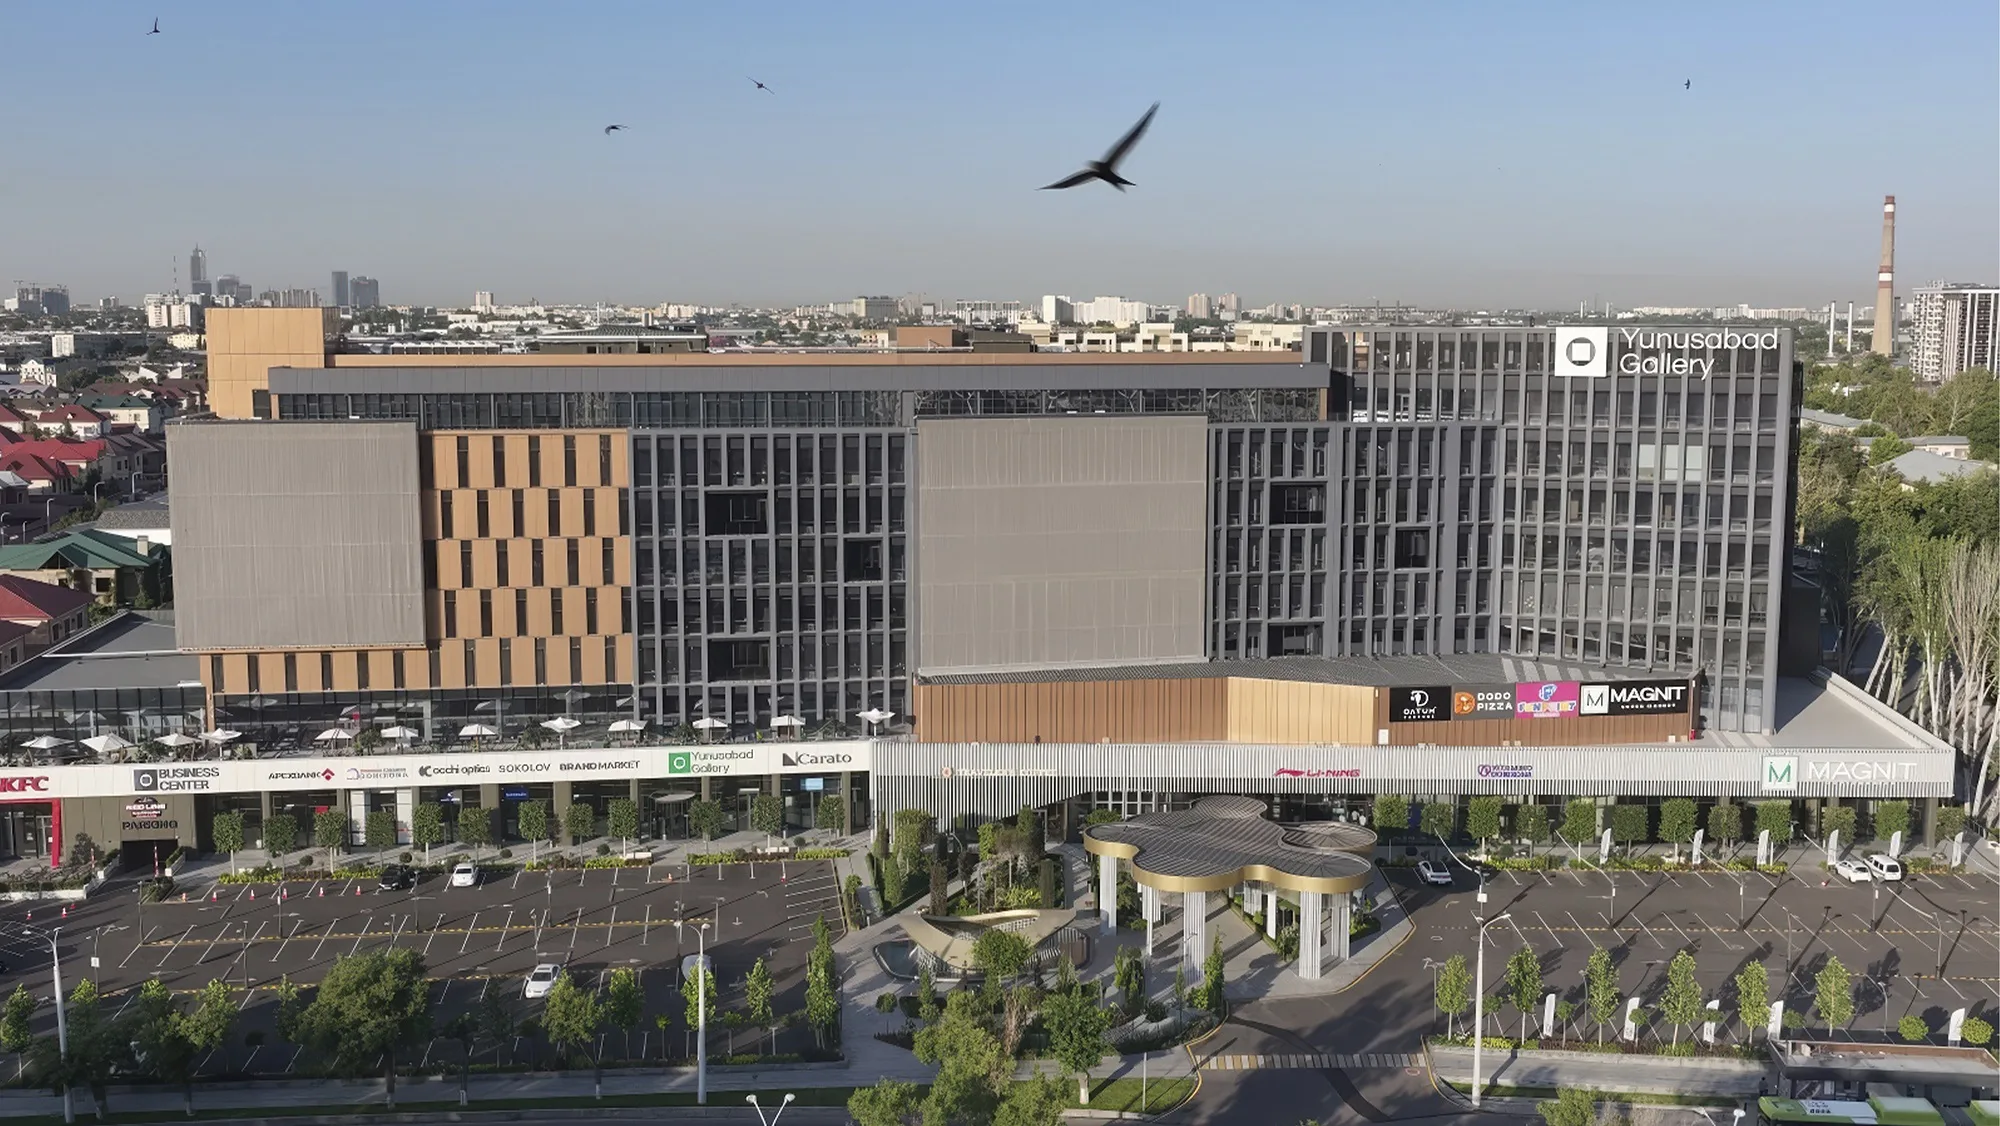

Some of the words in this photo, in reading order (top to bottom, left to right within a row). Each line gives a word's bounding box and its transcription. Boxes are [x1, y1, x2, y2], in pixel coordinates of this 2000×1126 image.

[1620, 327, 1778, 350] Yunusabad
[1620, 352, 1715, 381] Gallery
[1477, 692, 1511, 701] DODO
[1610, 686, 1687, 703] MAGNIT
[1477, 702, 1513, 711] PIZZA
[691, 749, 754, 761] Yunusabad
[799, 752, 852, 765] Carato
[433, 764, 460, 775] occhi
[499, 763, 551, 773] SOKOLOV
[559, 762, 597, 771] BRAND
[598, 760, 641, 771] MARKET
[691, 763, 730, 774] Gallery
[1807, 761, 1918, 780] MAGNIT
[159, 767, 220, 778] BUSINESS
[1768, 761, 1792, 783] M
[0, 775, 50, 793] KFC
[159, 779, 210, 791] CENTER
